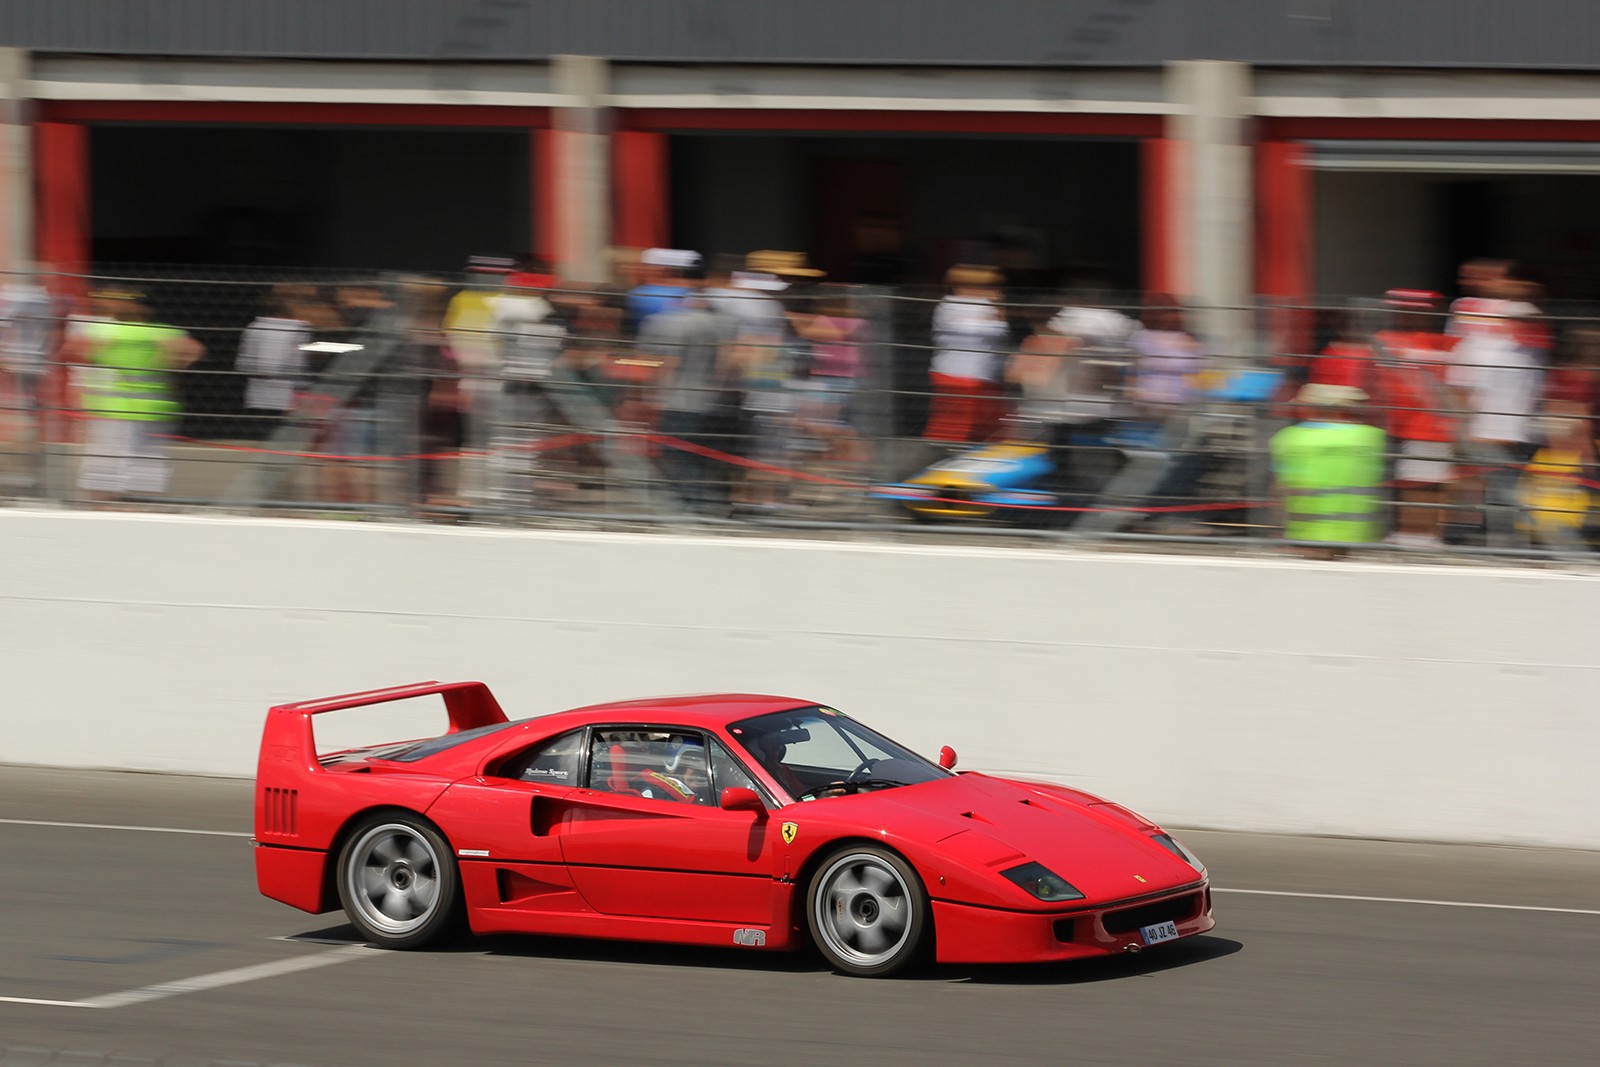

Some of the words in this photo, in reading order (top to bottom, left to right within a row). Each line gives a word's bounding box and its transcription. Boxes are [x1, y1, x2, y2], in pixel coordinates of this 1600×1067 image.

[1148, 928, 1158, 941] 40
[1158, 926, 1167, 939] JZ
[1167, 924, 1176, 936] 46
